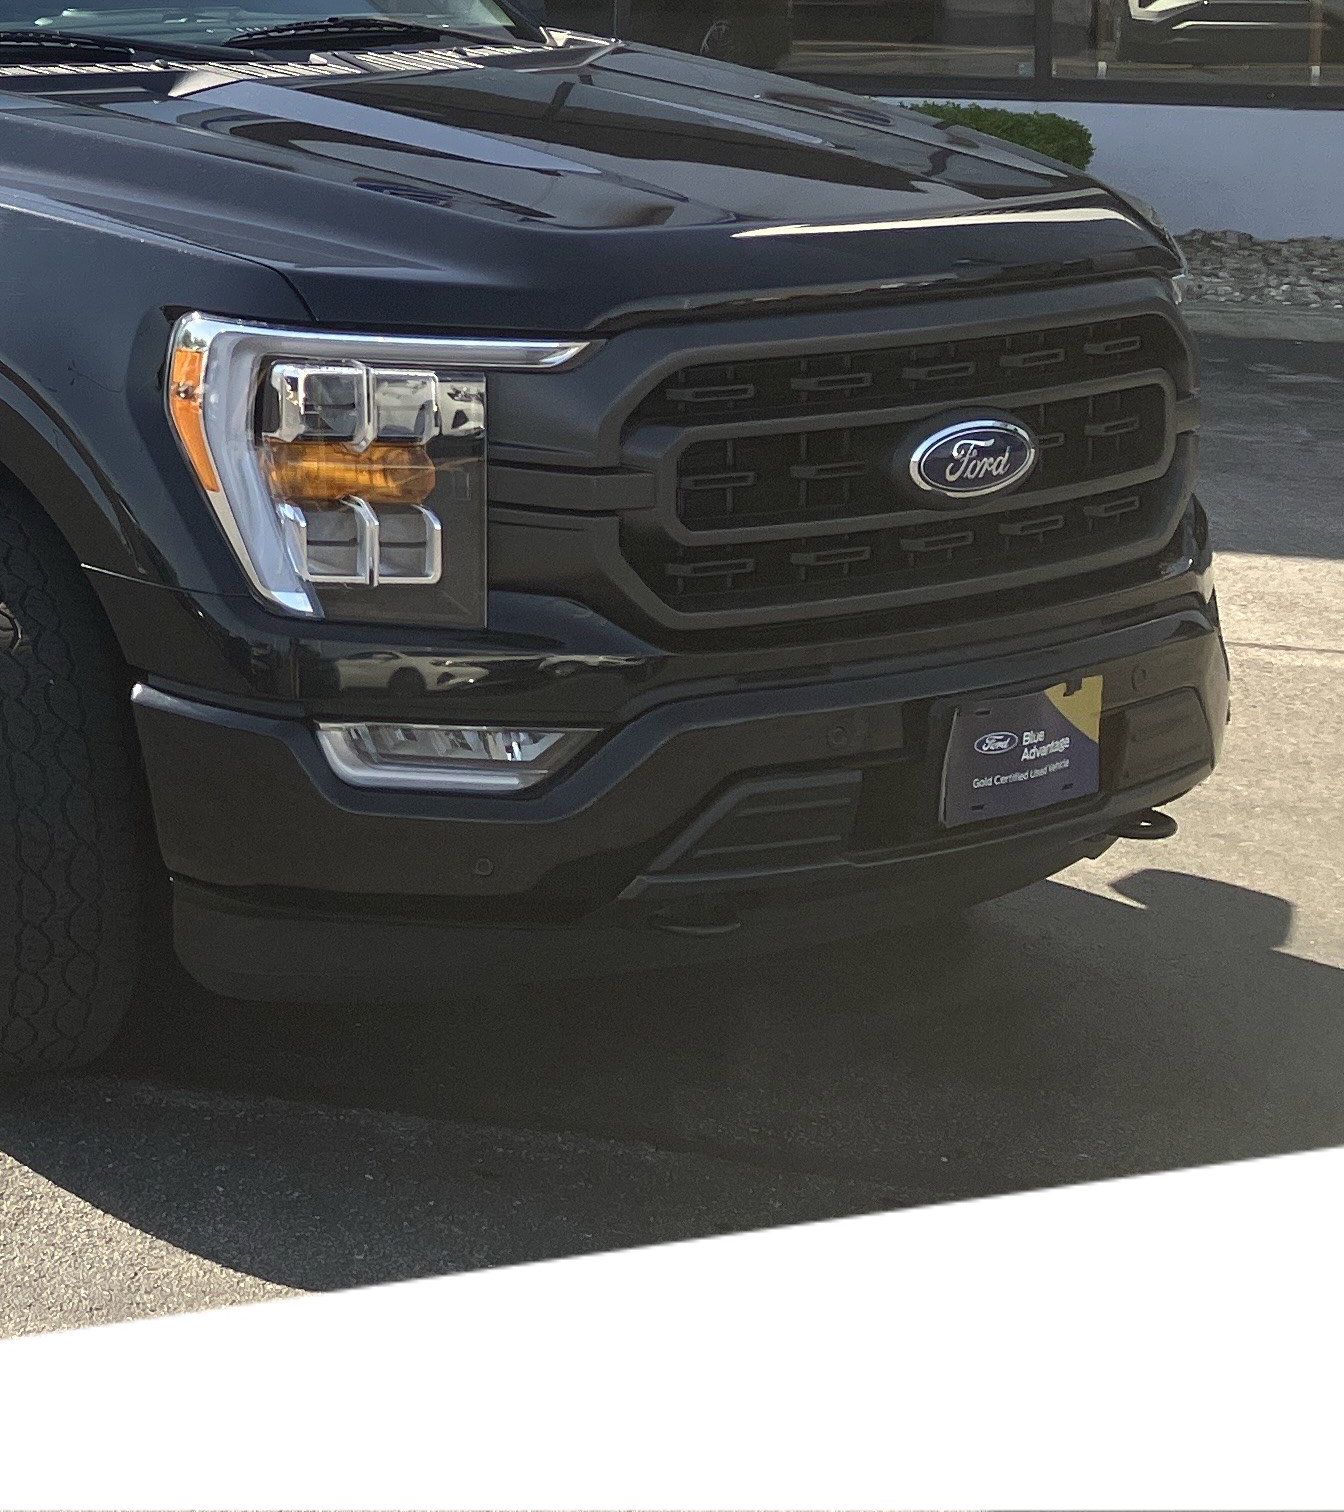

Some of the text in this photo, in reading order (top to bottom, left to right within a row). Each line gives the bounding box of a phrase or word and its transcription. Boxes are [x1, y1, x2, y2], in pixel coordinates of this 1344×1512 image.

[945, 438, 1011, 482] Ford
[981, 730, 1045, 751] Ford Blue
[1020, 736, 1071, 762] Advantage
[972, 776, 993, 789] Gold
[993, 769, 1029, 786] Certified
